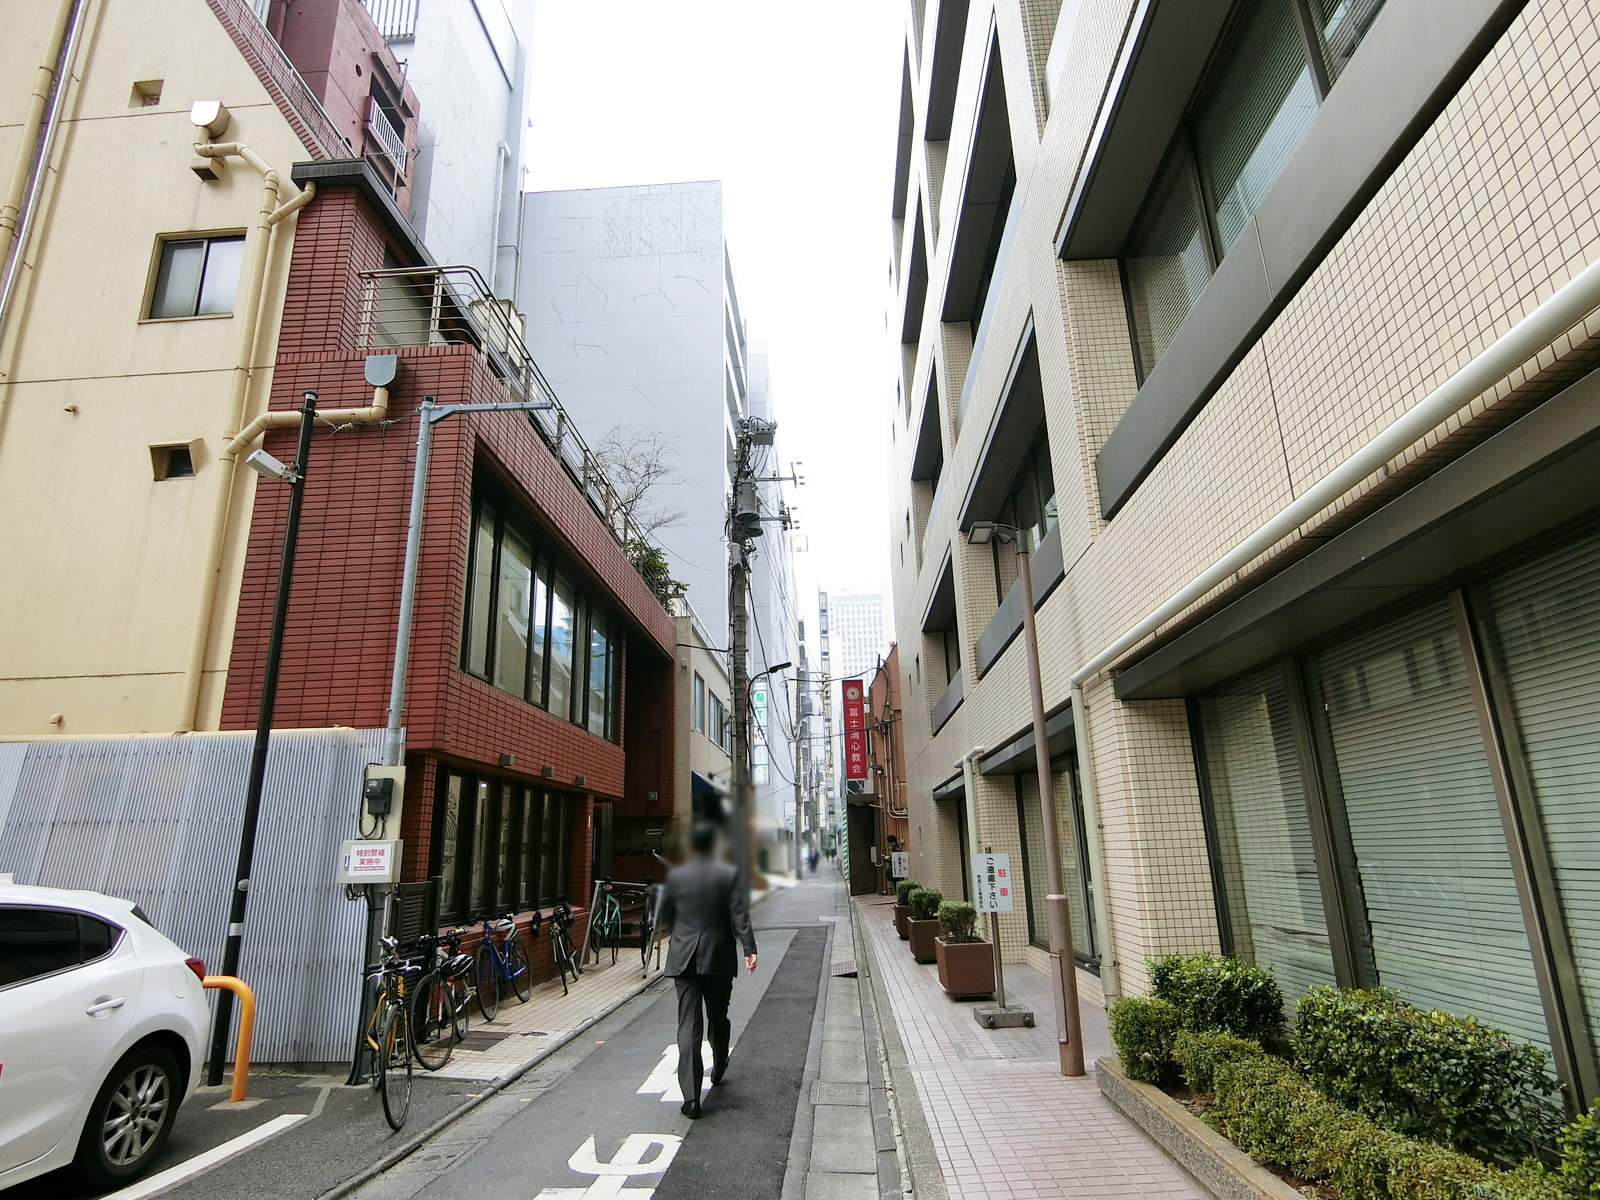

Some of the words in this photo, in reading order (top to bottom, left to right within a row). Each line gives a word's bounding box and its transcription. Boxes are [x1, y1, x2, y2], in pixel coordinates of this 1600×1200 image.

[356, 849, 385, 857] 特別警戒
[359, 858, 381, 866] 実施中
[986, 857, 998, 909] ご遠慮下さい
[997, 868, 1009, 897] 駐車
